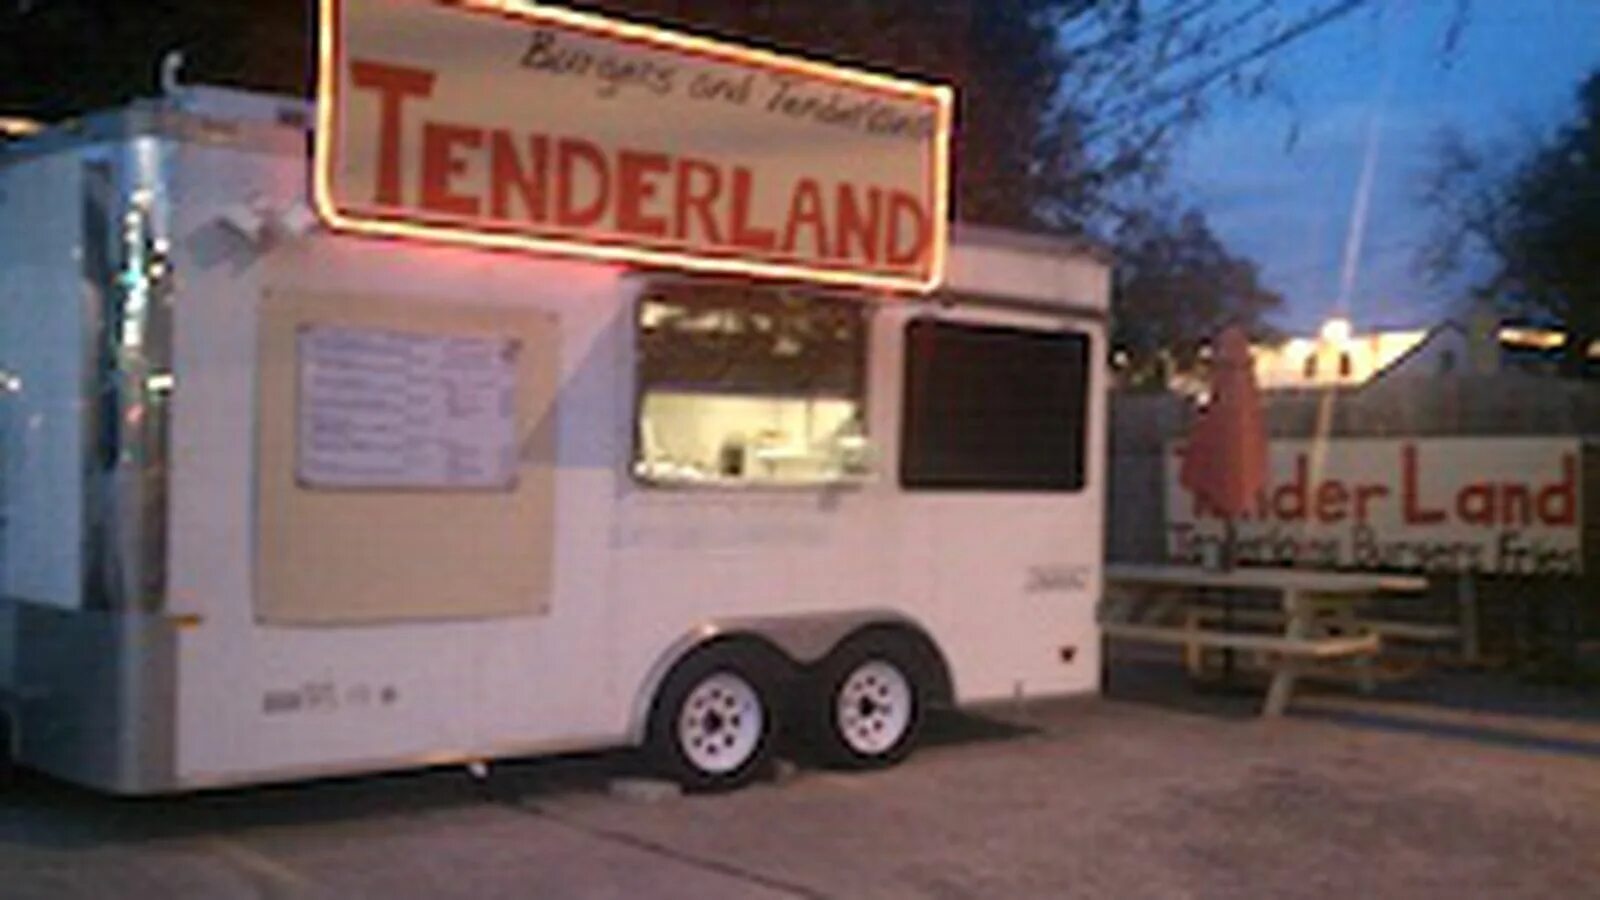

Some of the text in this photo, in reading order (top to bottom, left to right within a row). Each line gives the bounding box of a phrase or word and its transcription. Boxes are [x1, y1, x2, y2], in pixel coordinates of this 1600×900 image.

[520, 30, 676, 98] Burgers
[689, 71, 756, 105] and
[350, 60, 930, 267] TENDERLAND
[1404, 443, 1578, 528] Land
